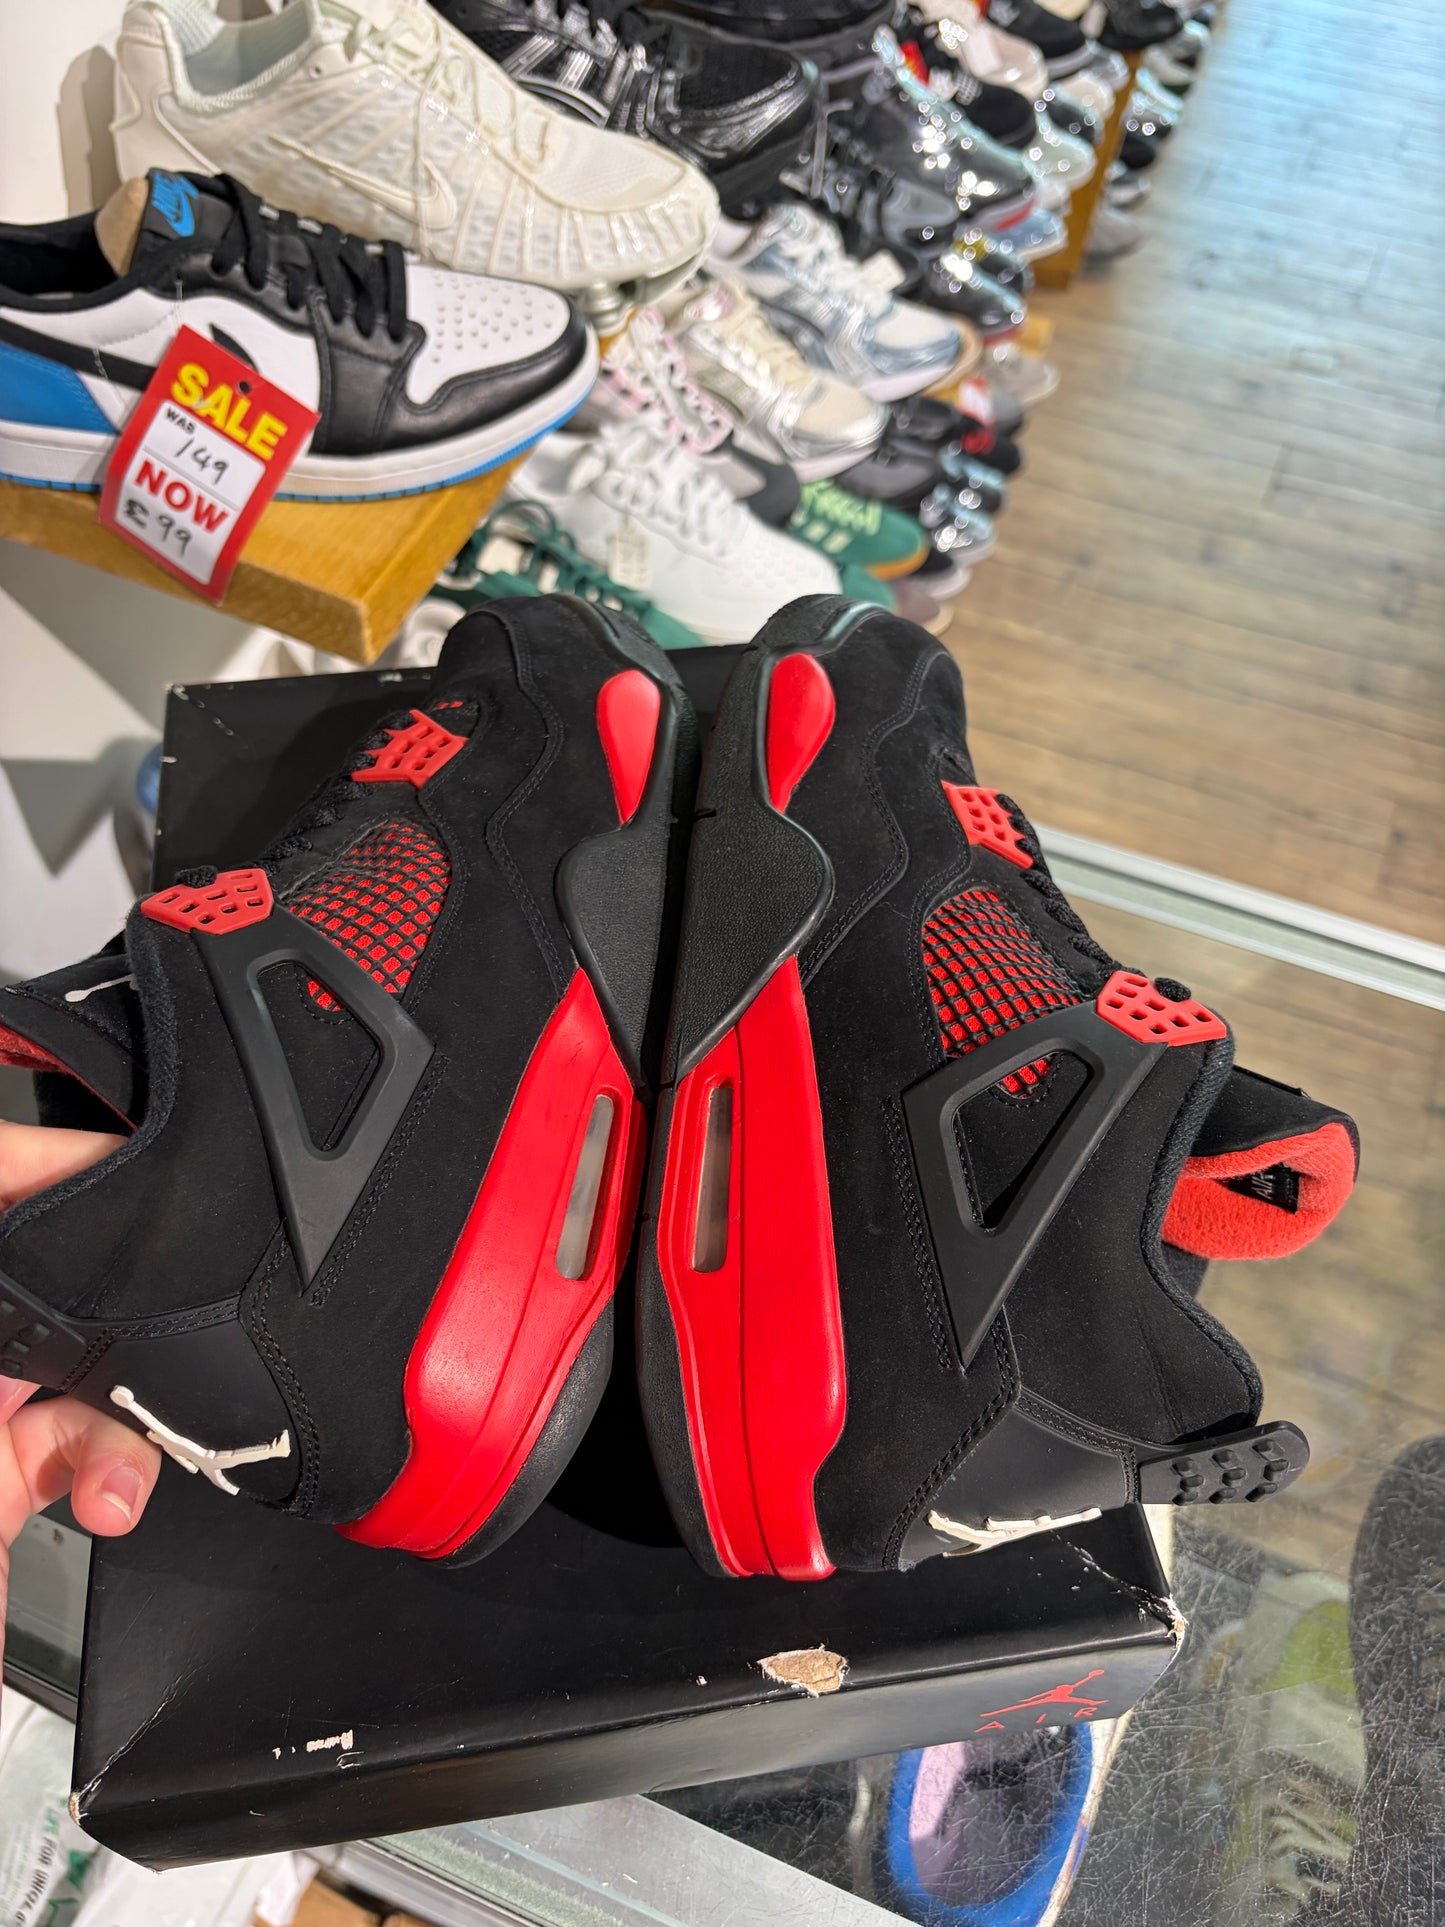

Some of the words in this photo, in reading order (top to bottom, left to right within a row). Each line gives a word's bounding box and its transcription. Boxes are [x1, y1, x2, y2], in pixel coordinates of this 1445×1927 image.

[166, 407, 196, 434] WAS
[171, 363, 288, 461] SALE
[133, 459, 229, 534] NOW
[975, 1707, 1098, 1733] AIR
